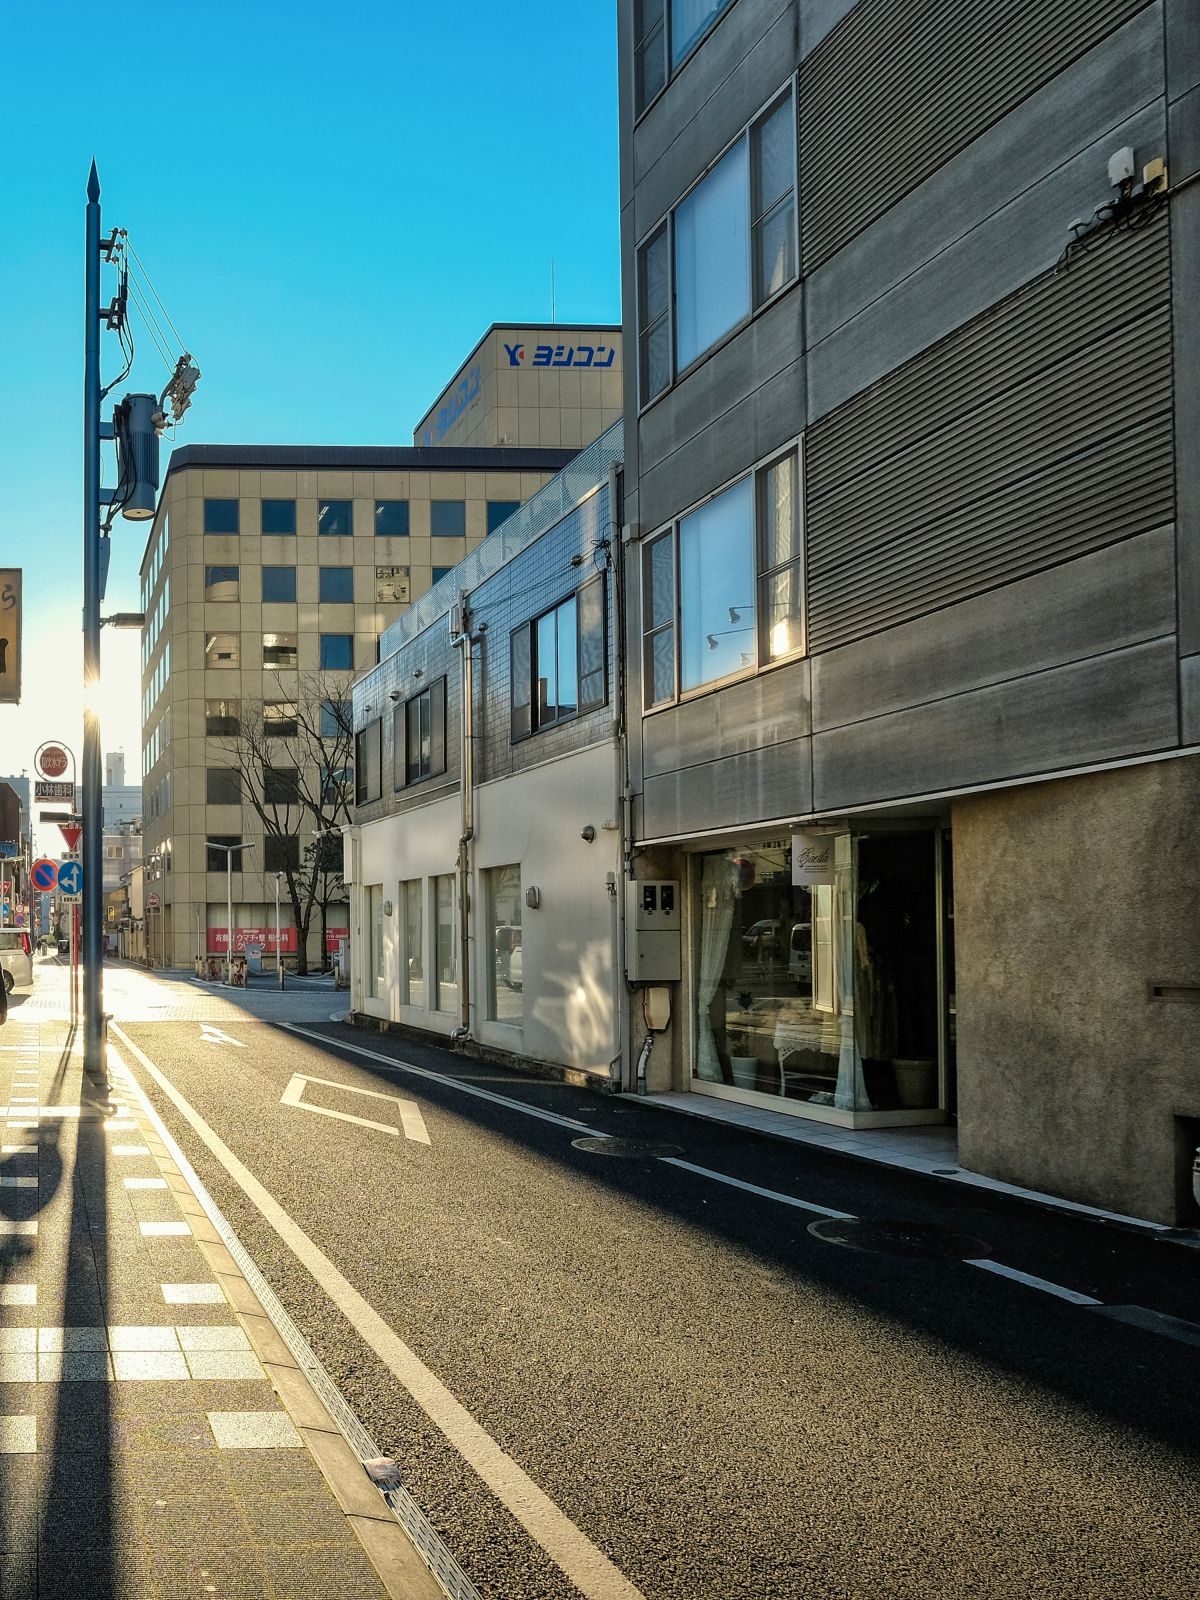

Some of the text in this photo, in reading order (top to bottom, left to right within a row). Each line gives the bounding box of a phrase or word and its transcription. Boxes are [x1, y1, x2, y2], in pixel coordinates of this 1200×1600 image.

[531, 345, 616, 367] ヨシコン
[36, 783, 73, 796] 小林歯科
